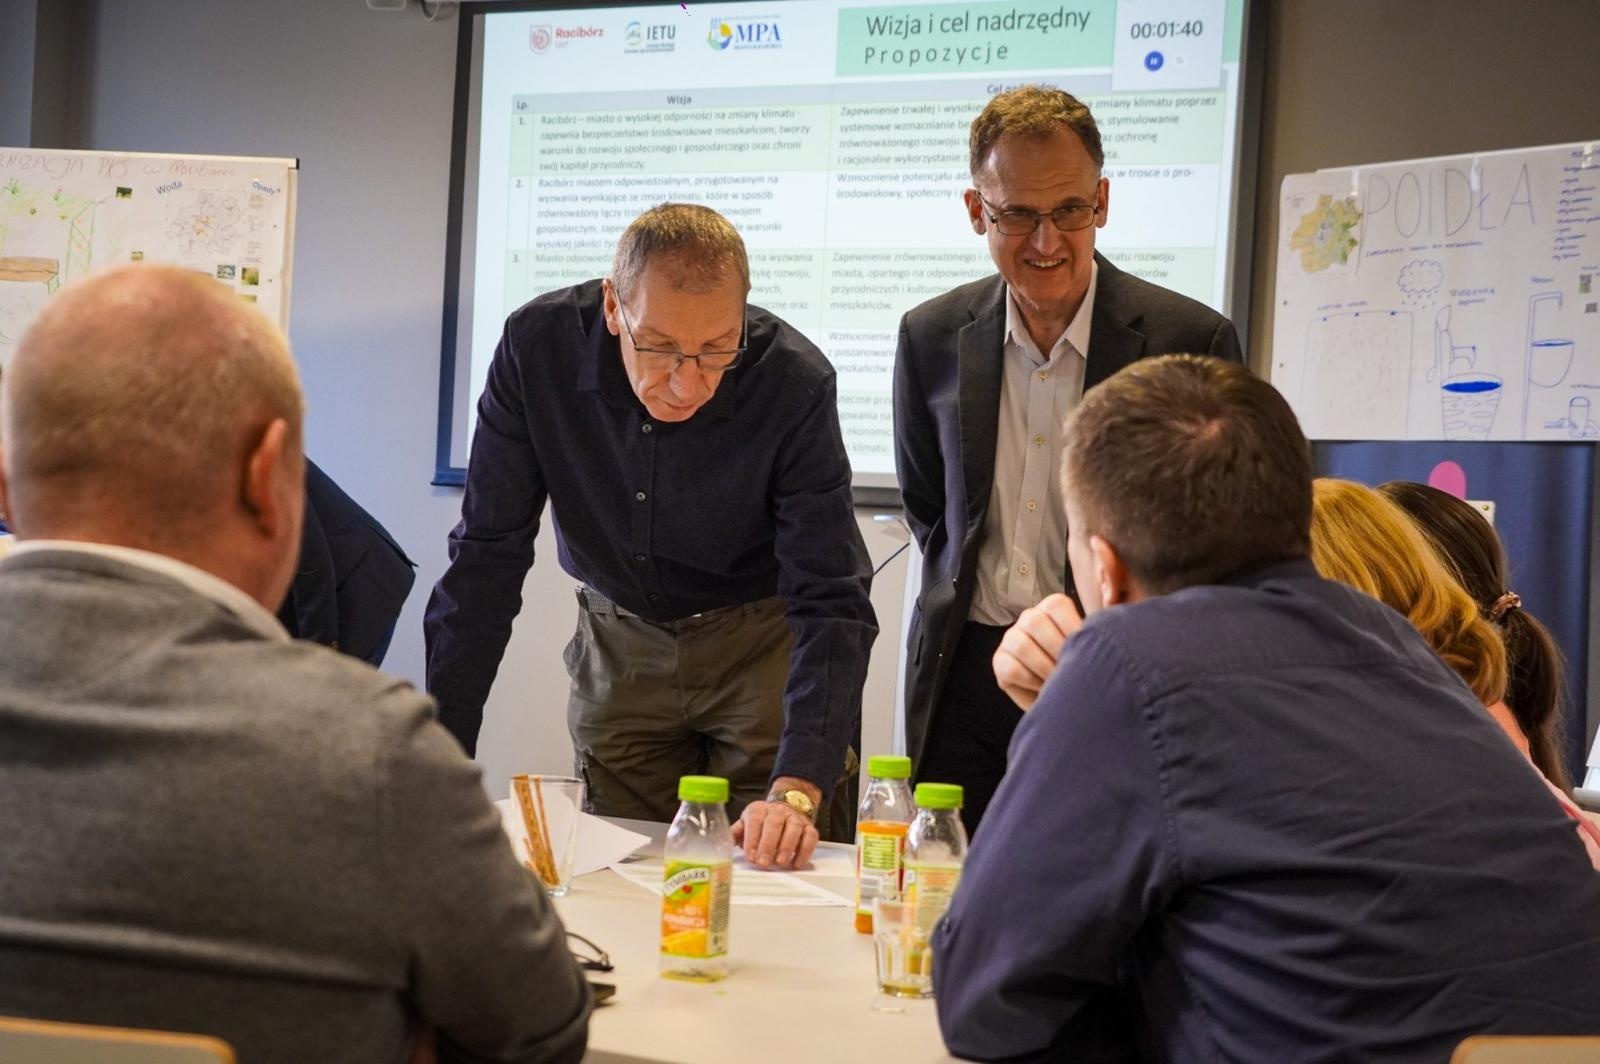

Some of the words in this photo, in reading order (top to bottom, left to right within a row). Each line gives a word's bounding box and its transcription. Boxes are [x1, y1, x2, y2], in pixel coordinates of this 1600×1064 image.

[866, 15, 922, 39] Wizja
[928, 15, 934, 34] i
[939, 11, 970, 33] cel
[976, 6, 1092, 34] nadrzędny
[1130, 20, 1204, 40] 00:01:40
[555, 26, 605, 39] Racibórz
[647, 24, 676, 41] IETU
[735, 23, 781, 42] MPA
[864, 43, 1009, 68] Propozycje
[667, 95, 692, 106] Wizja
[840, 106, 900, 117] Zapewnienie
[1095, 98, 1131, 109] zmiany
[1133, 96, 1173, 108] klimatu
[1175, 97, 1217, 109] poprzez
[541, 114, 577, 125] Racibórz
[585, 114, 615, 124] miasto
[616, 115, 623, 123] o
[625, 112, 662, 124] wysokiej
[664, 110, 713, 122] odporności
[714, 112, 726, 120] na
[728, 109, 759, 120] zmiany
[761, 108, 796, 119] klimatu
[840, 121, 892, 133] systemowe
[894, 120, 955, 131] wzmacnianie
[1107, 115, 1180, 128] stymulowanie
[540, 130, 580, 141] zapewnia
[581, 127, 649, 140] bezpieczeństwo
[651, 125, 713, 138] środowiskowe
[779, 124, 811, 135] tworzy
[839, 136, 920, 149] zrównoważonego
[922, 136, 960, 148] rozwoju
[1114, 131, 1158, 143] ochronę
[540, 145, 574, 156] warunki
[575, 144, 587, 154] do
[588, 145, 622, 156] rozwoju
[624, 142, 678, 155] społecznego
[683, 141, 750, 154] gospodarczego
[751, 141, 770, 151] oraz
[772, 139, 802, 150] chroni
[842, 154, 892, 167] racjonalne
[894, 152, 961, 166] wykorzystanie
[516, 179, 524, 188] 2.
[538, 177, 574, 188] Racibórz
[575, 176, 613, 187] miastem
[694, 173, 766, 186] przygotowanym
[767, 175, 779, 184] na
[836, 173, 899, 183] Wzmocnienie
[1128, 168, 1161, 178] trosce
[537, 194, 579, 204] wyzwania
[628, 193, 638, 201] ze
[640, 192, 667, 201] zmian
[705, 189, 729, 200] które
[741, 188, 773, 201] sposób
[1365, 162, 1536, 239] POIDŁA
[537, 207, 599, 219] zrównoważony
[566, 252, 614, 265] odpowiedz
[768, 253, 813, 264] wyzwania
